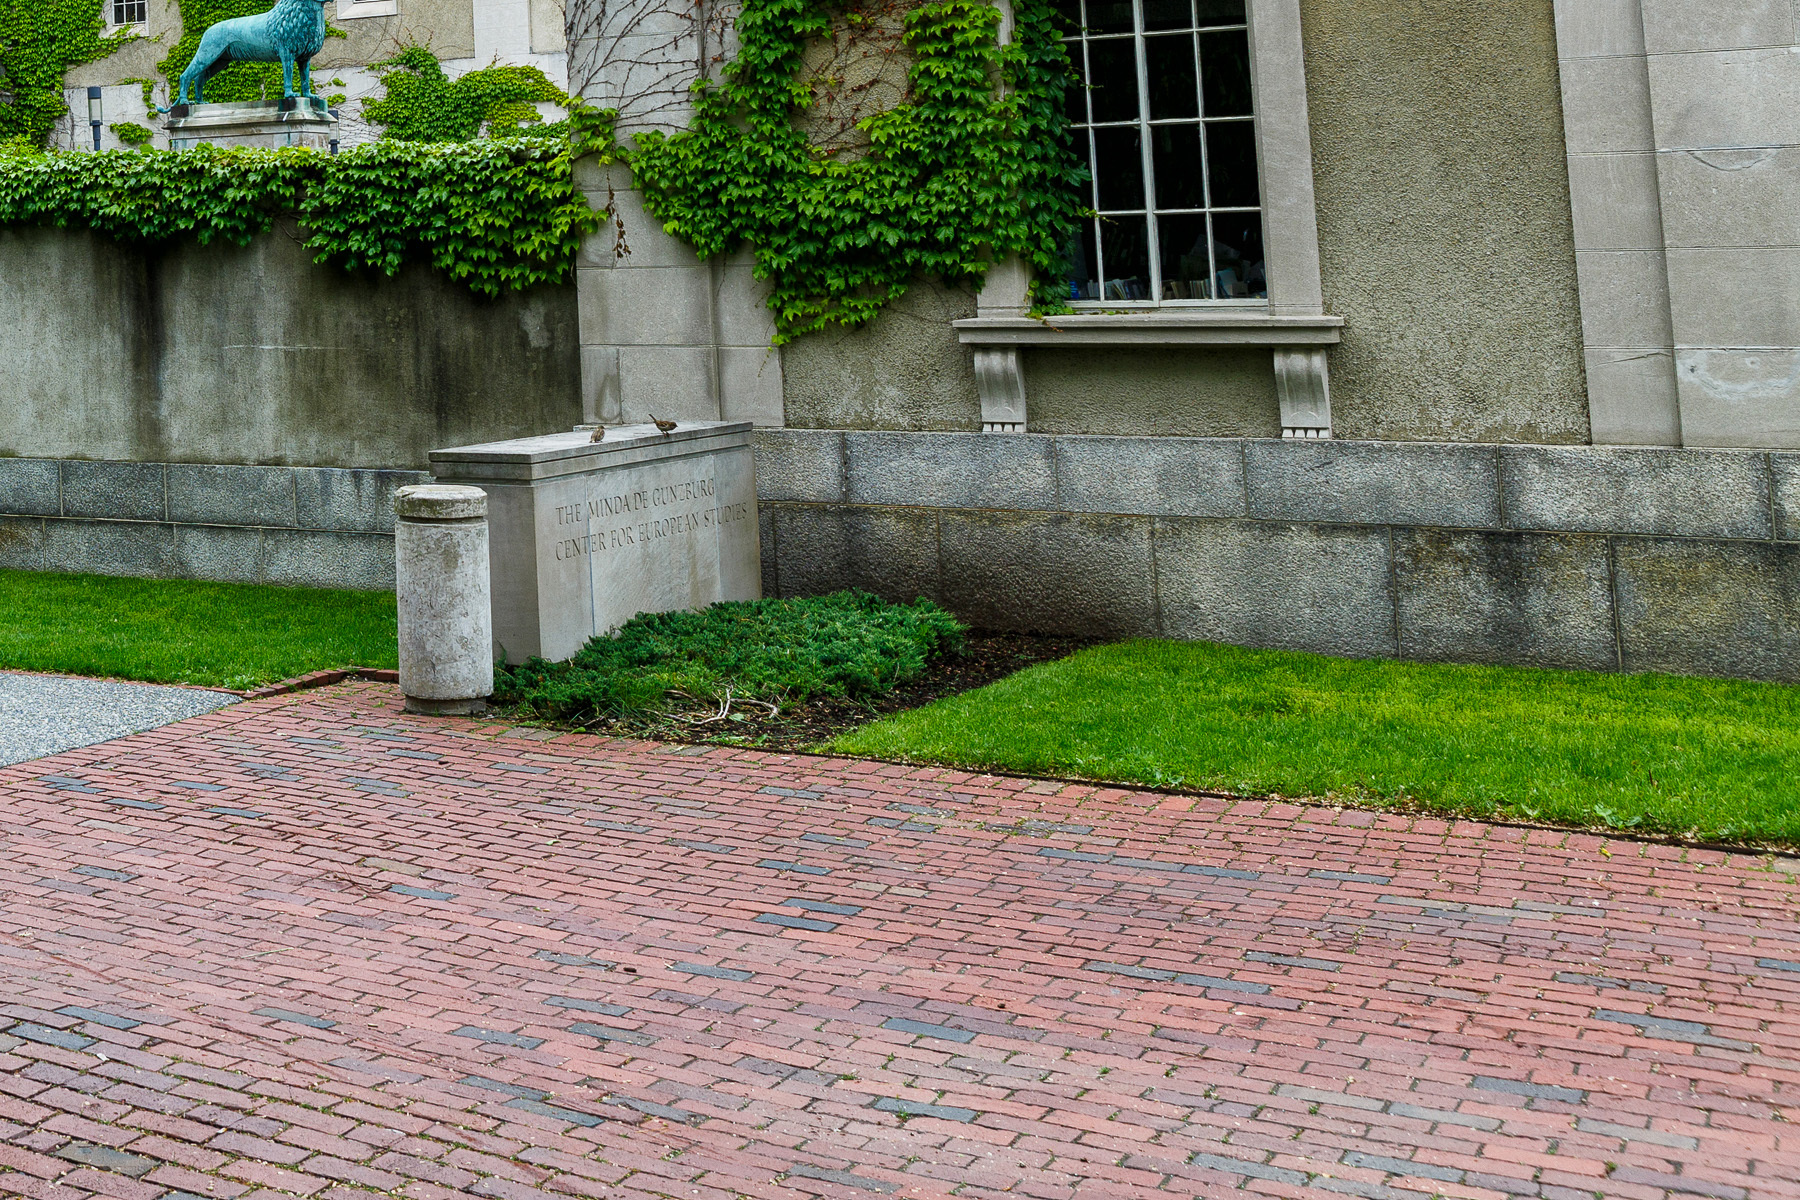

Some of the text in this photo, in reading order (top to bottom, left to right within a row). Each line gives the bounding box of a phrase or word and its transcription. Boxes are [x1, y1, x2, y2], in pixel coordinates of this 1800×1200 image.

[555, 478, 715, 525] THE MINDA DE GUNZBURG
[555, 502, 747, 561] CENTER FOR EUROPEAN STUDIES
